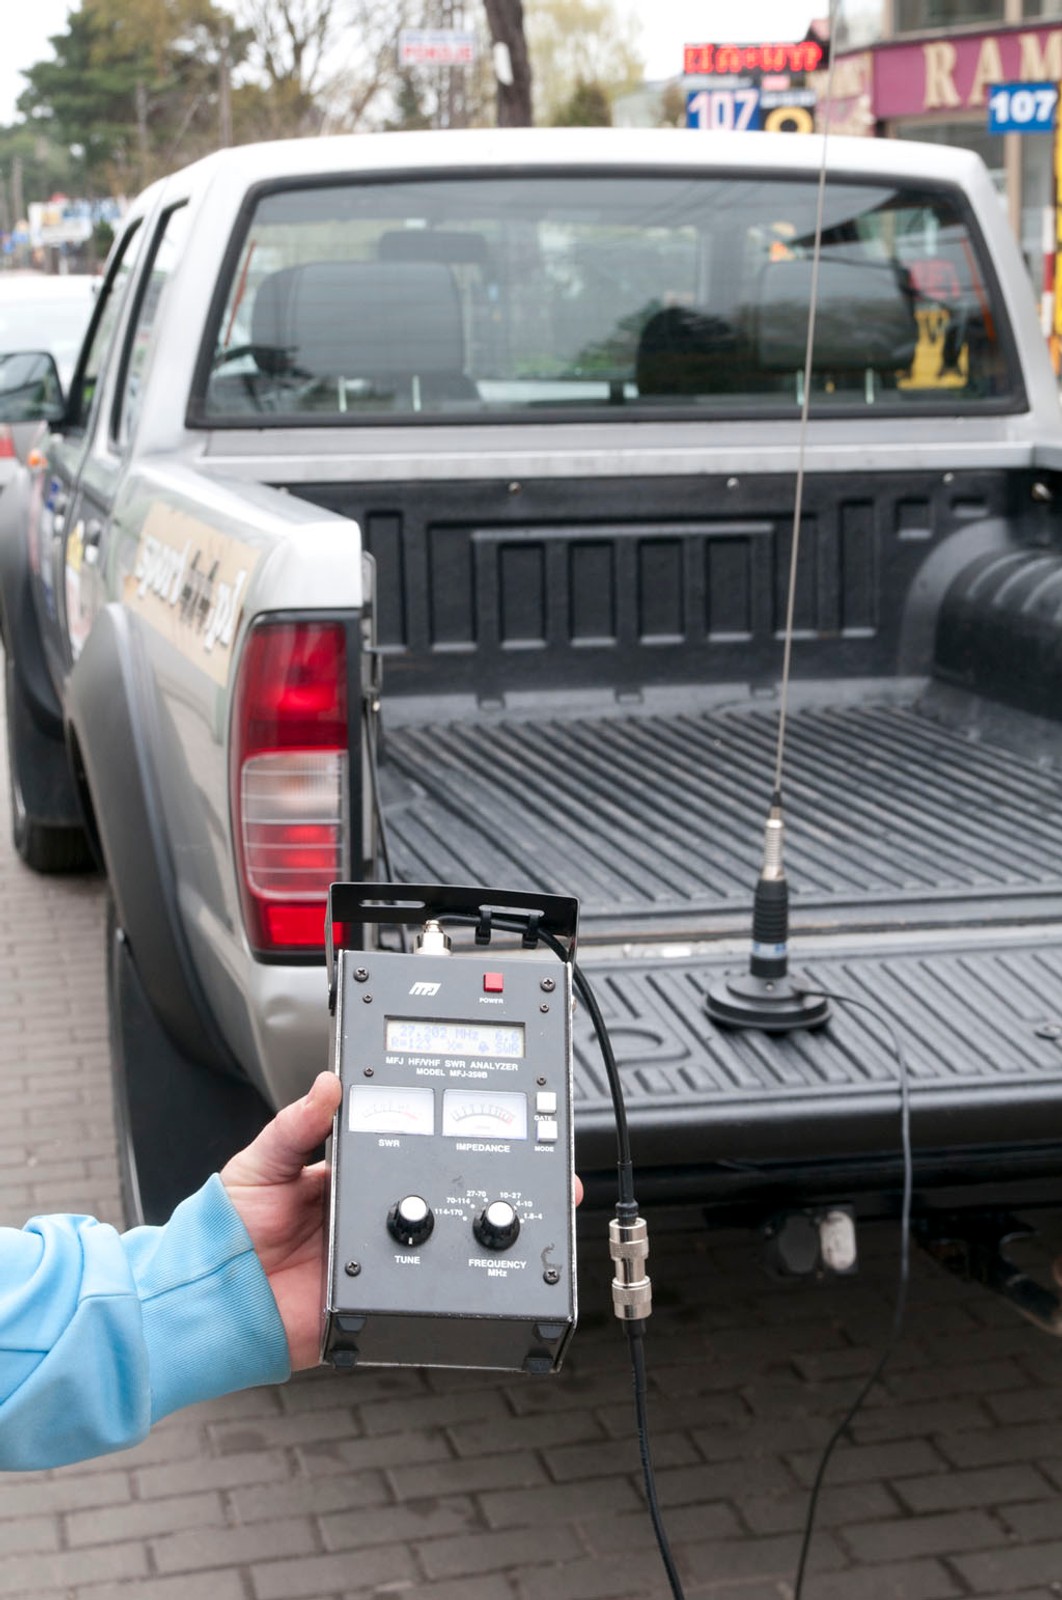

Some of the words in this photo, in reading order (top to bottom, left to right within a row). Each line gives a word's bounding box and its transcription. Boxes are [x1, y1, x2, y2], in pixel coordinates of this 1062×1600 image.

[688, 88, 759, 130] 107
[989, 90, 1057, 124] 107
[386, 1056, 404, 1065] MFJ
[408, 1058, 441, 1067] HF/VHF
[445, 1059, 466, 1068] SWR
[470, 1061, 519, 1071] ANALYZER
[416, 1068, 446, 1077] MODEL
[378, 1139, 400, 1147] SWR
[456, 1143, 510, 1153] IMPEDANCE
[466, 1190, 487, 1198] 27-70
[515, 1200, 533, 1208] 4-10
[434, 1208, 463, 1216] 114-170
[394, 1255, 421, 1264] TUNE
[468, 1258, 527, 1270] FREQUENCY
[487, 1268, 508, 1278] MHz
